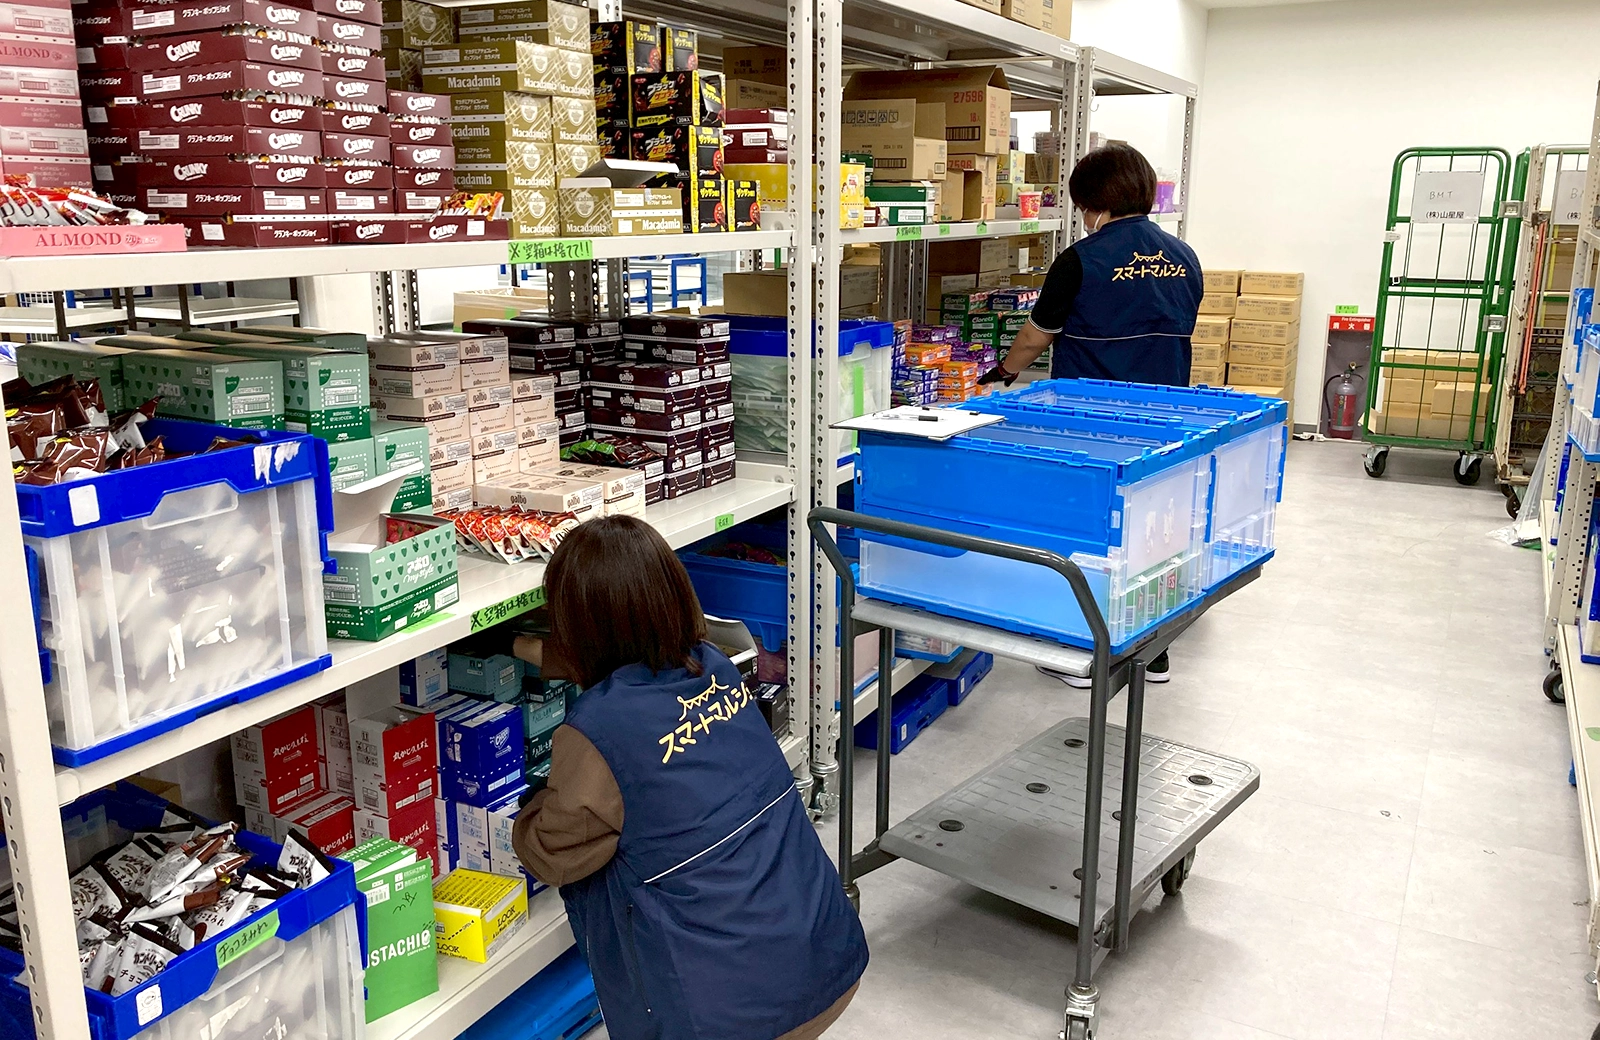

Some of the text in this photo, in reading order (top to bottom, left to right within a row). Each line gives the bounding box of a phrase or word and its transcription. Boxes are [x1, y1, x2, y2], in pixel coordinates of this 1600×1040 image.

[266, 6, 300, 23] CRUNKY
[333, 23, 365, 39] CRUNKY
[166, 41, 201, 60] CRUNKY
[271, 45, 303, 60] CRUNKY
[338, 58, 367, 72] CRUNKY
[268, 70, 304, 86] CRUNKY
[448, 75, 500, 88] Macadamia
[336, 82, 370, 96] CRUNKY
[407, 96, 436, 111] CRUNKY
[953, 90, 984, 103] 27596
[170, 104, 202, 121] CRUNKY
[270, 108, 304, 123] CRUNKY
[342, 115, 372, 129] CRUNKY
[409, 127, 437, 140] CRUNKY
[268, 133, 303, 149] CRUNKY
[343, 139, 374, 154] CRUNKY
[413, 149, 442, 163] CRUNKY
[174, 163, 208, 180] CRUNKY
[277, 168, 308, 182] CRUNKY
[345, 170, 374, 184] CRUNKY
[415, 172, 441, 185] CRUNKY
[1425, 211, 1464, 219] (株)山星屋
[356, 224, 385, 238] CRUNKY
[429, 224, 459, 240] CRUNKY
[642, 220, 680, 230] Macadamia
[36, 232, 122, 247] ALMOND
[1112, 264, 1186, 281] スマートマルシェ
[416, 351, 431, 363] galbo
[465, 345, 480, 355] galbo
[517, 384, 530, 394] galbo
[473, 392, 487, 403] galbo
[428, 401, 442, 413] galbo
[522, 429, 535, 440] galbo
[478, 439, 492, 450] galbo
[612, 483, 624, 494] galbo
[510, 495, 528, 505] galbo
[567, 495, 580, 507] galbo
[407, 555, 429, 574] アポロ
[497, 905, 515, 927] LOOK
[219, 922, 268, 962] チョコまみれ
[367, 929, 431, 969] ISTACHIO
[436, 943, 460, 953] LOOK
